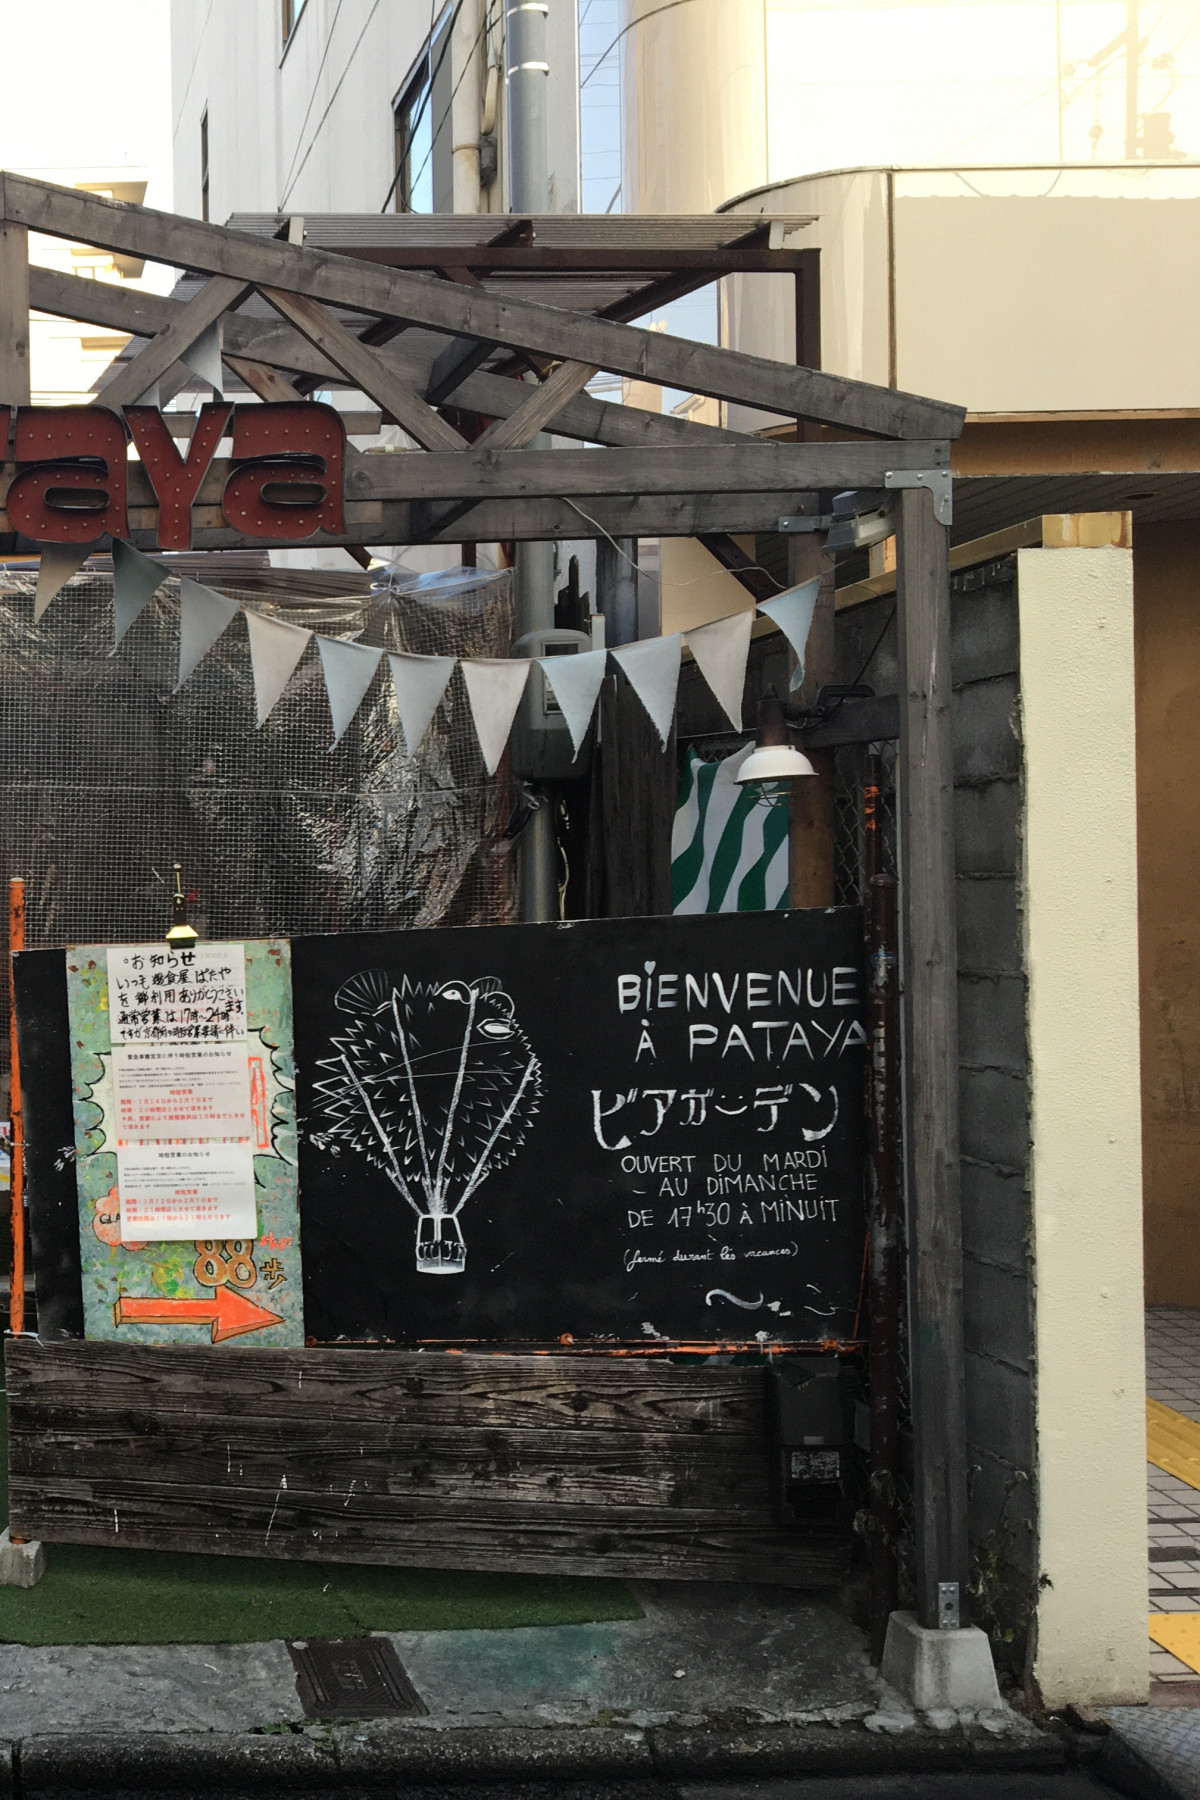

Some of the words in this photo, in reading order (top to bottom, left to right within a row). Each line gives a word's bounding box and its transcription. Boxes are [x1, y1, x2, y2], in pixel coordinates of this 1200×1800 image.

[688, 1019, 868, 1062] PATAYA
[621, 1155, 697, 1174] OUVERT
[714, 1153, 742, 1173] DU
[659, 1177, 688, 1197] AU
[627, 1209, 654, 1228] DE
[673, 1249, 713, 1262] durant
